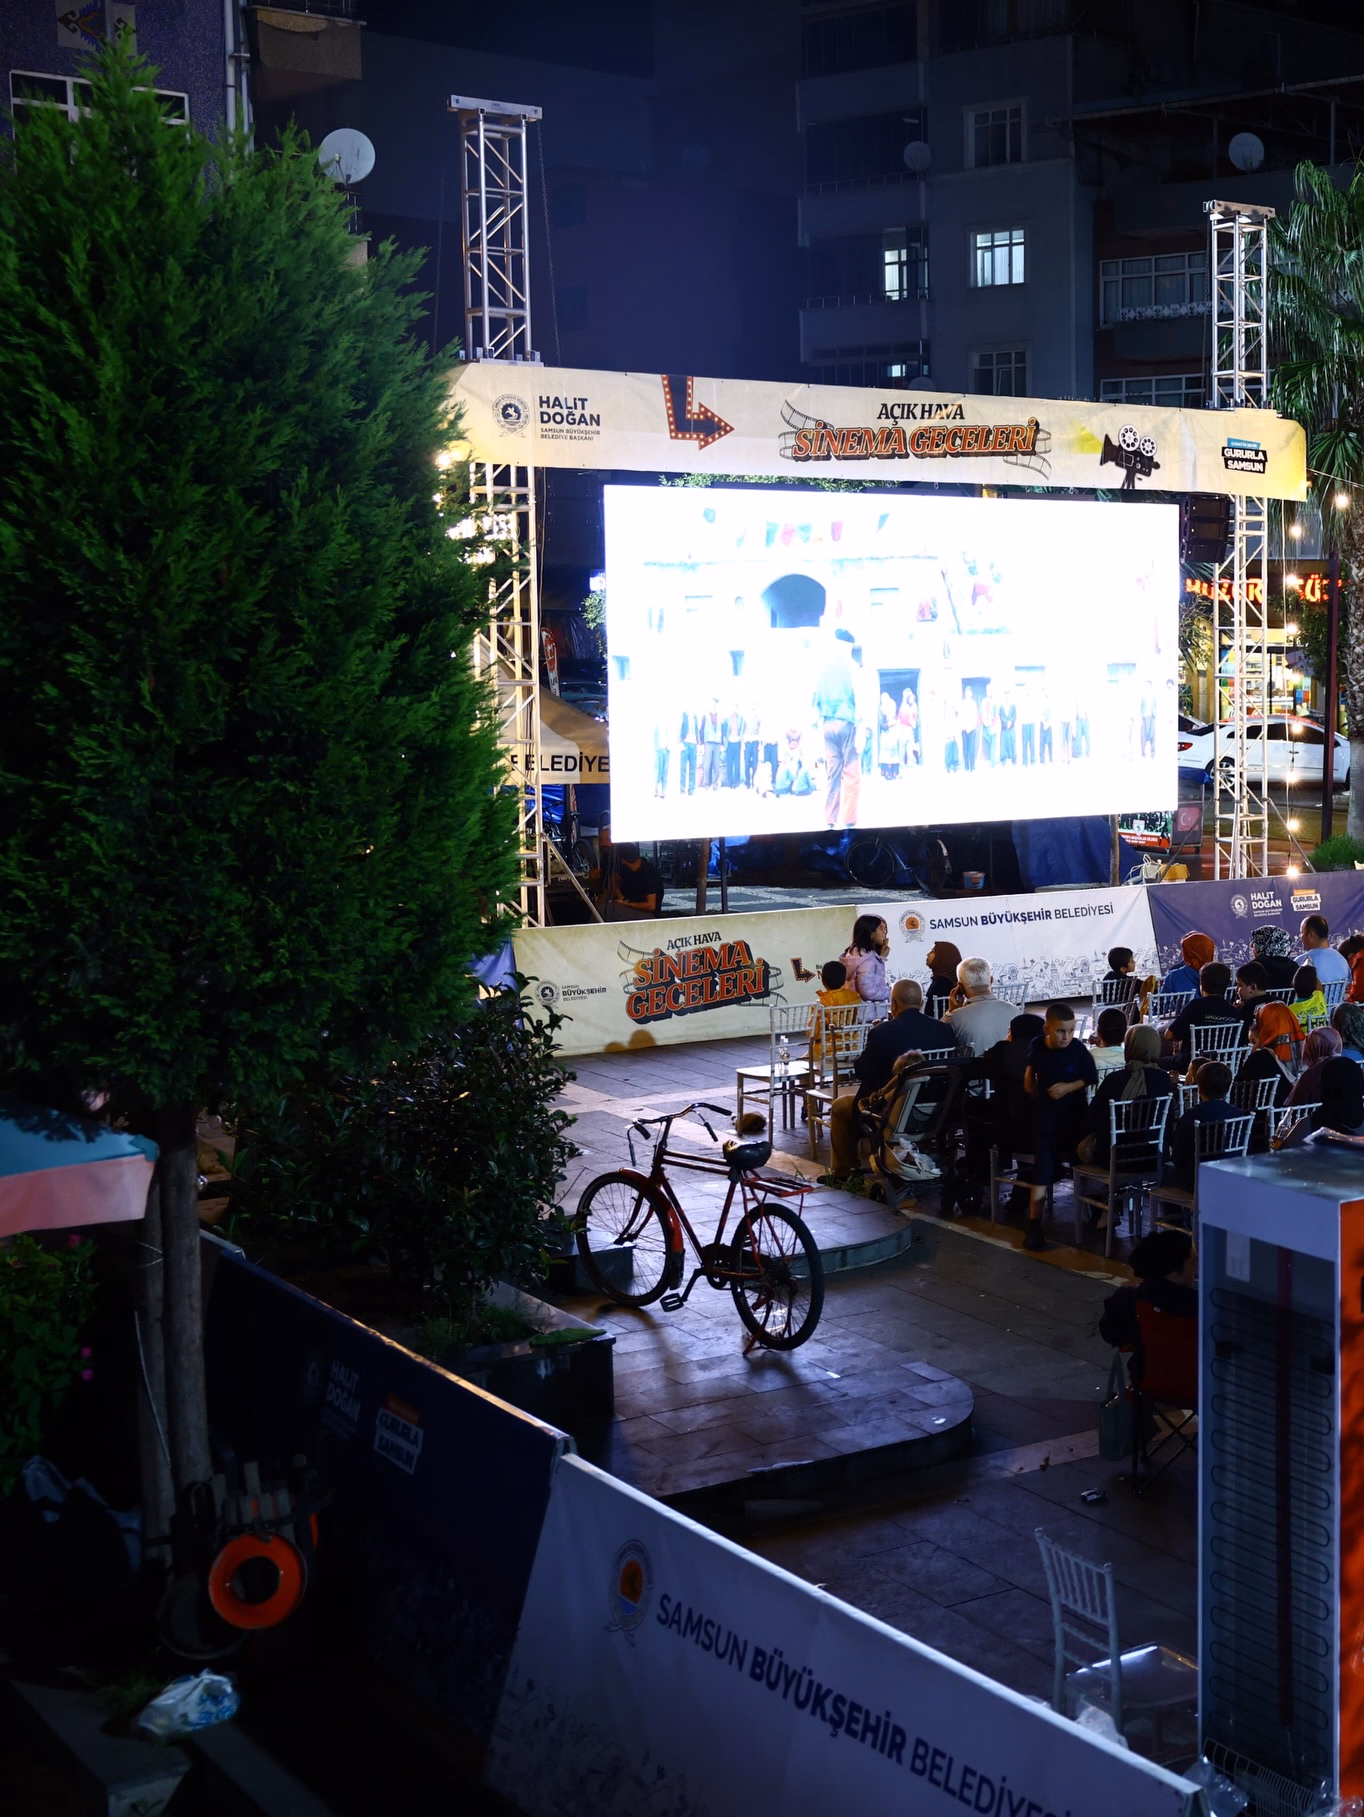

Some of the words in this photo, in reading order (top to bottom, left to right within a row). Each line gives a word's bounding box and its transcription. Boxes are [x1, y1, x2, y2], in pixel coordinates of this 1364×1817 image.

[539, 410, 601, 427] DOĞAN
[877, 402, 916, 426] AÇIK
[919, 403, 966, 420] HAVA
[792, 419, 907, 459] SİNEMA
[909, 416, 1038, 457] GECELERİ
[1223, 447, 1265, 461] GURURLA
[1227, 459, 1264, 472] SAMSUN
[929, 915, 979, 930] SAMSUN
[980, 907, 1053, 926] BÜYÜKŞEHİR
[1054, 902, 1115, 920] BELEDİYESİ
[666, 935, 692, 951] AÇIK
[693, 931, 722, 946] HAVA
[632, 939, 753, 988] SİNEMA
[562, 986, 607, 996] BÜYÜKŞEHİR
[625, 957, 768, 1022] GECELERİ
[656, 1593, 749, 1672] SAMSUN
[749, 1647, 907, 1766] BÜYÜKŞEHİR
